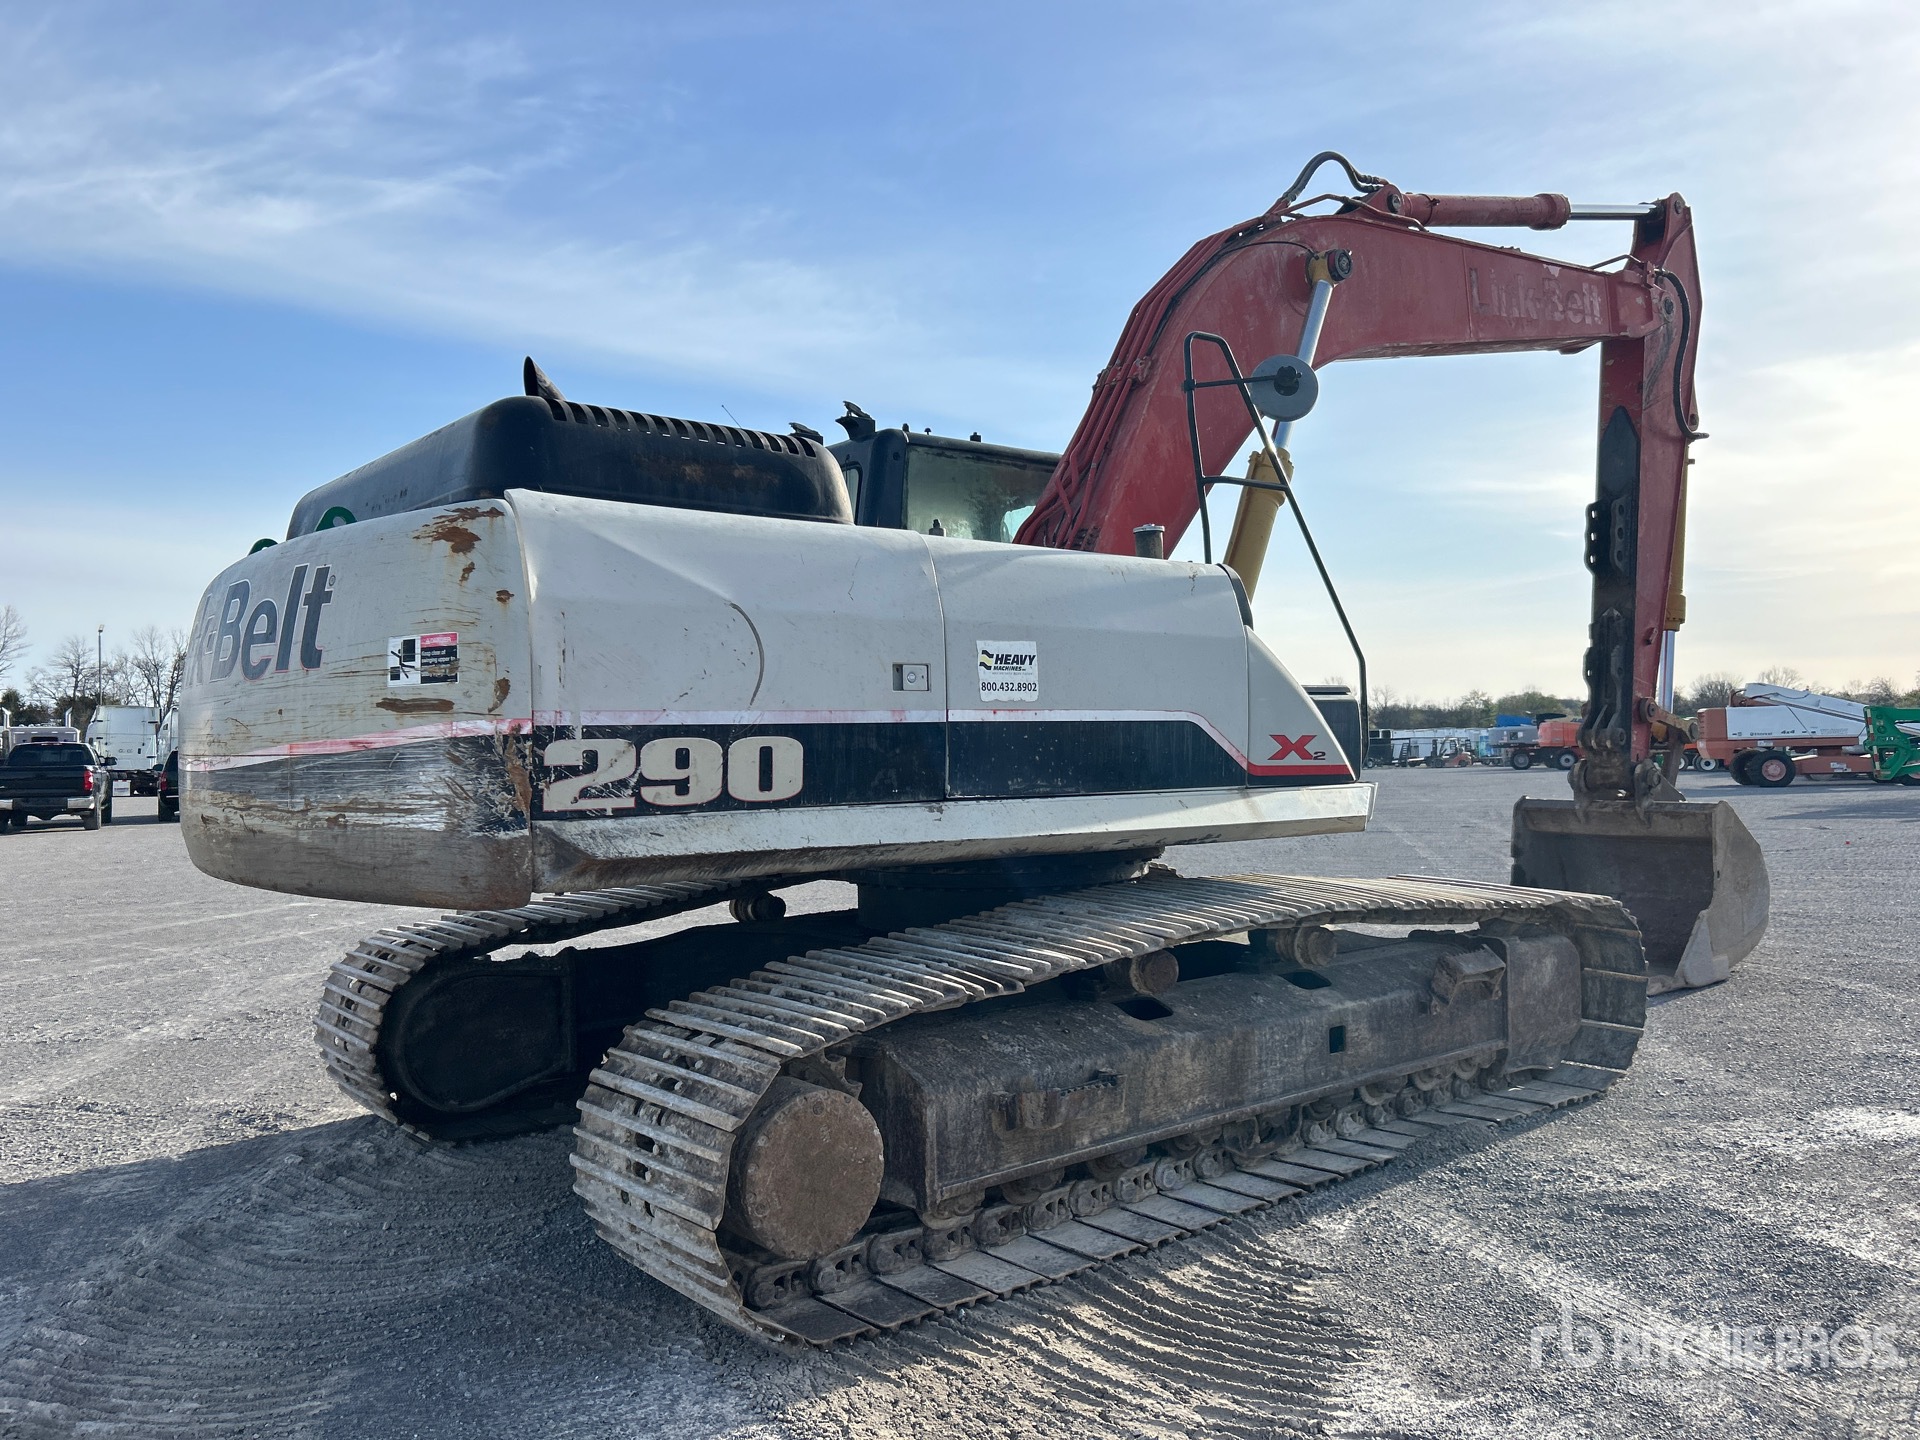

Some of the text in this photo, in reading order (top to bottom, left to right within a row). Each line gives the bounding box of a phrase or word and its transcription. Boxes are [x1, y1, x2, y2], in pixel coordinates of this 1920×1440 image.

[1469, 267, 1603, 325] Link-Belt
[994, 654, 1036, 665] HEAVY
[981, 681, 1037, 692] 800.432.8902
[1267, 734, 1327, 761] X2
[542, 736, 804, 812] 290
